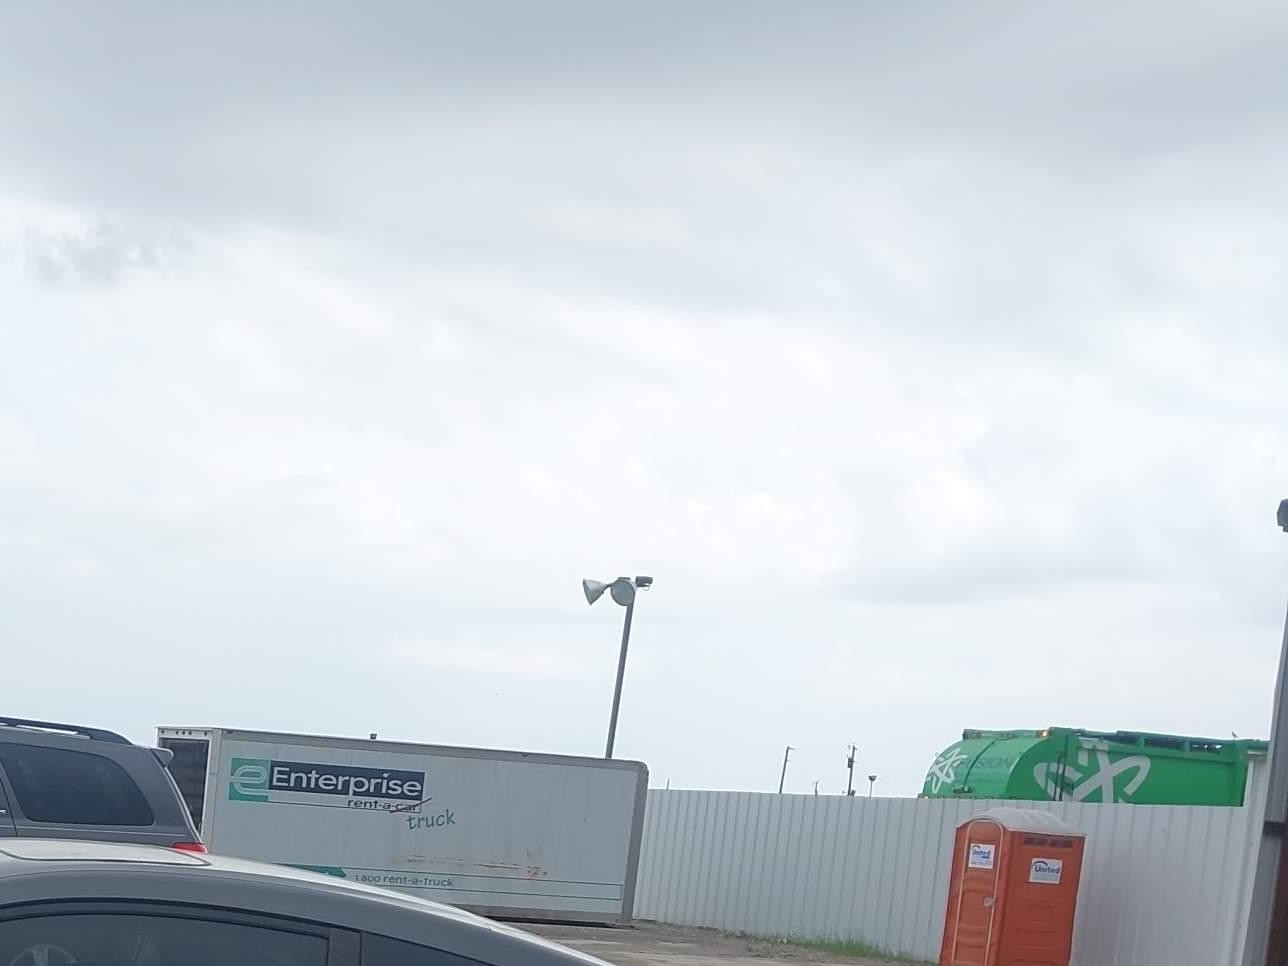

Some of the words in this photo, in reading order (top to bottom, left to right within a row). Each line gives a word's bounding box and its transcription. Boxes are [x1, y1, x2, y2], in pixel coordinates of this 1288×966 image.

[271, 767, 422, 797] Enterprise
[347, 799, 418, 811] rent-a-car
[406, 809, 455, 830] truck
[1034, 864, 1061, 874] United
[383, 875, 454, 887] rent-a-truck
